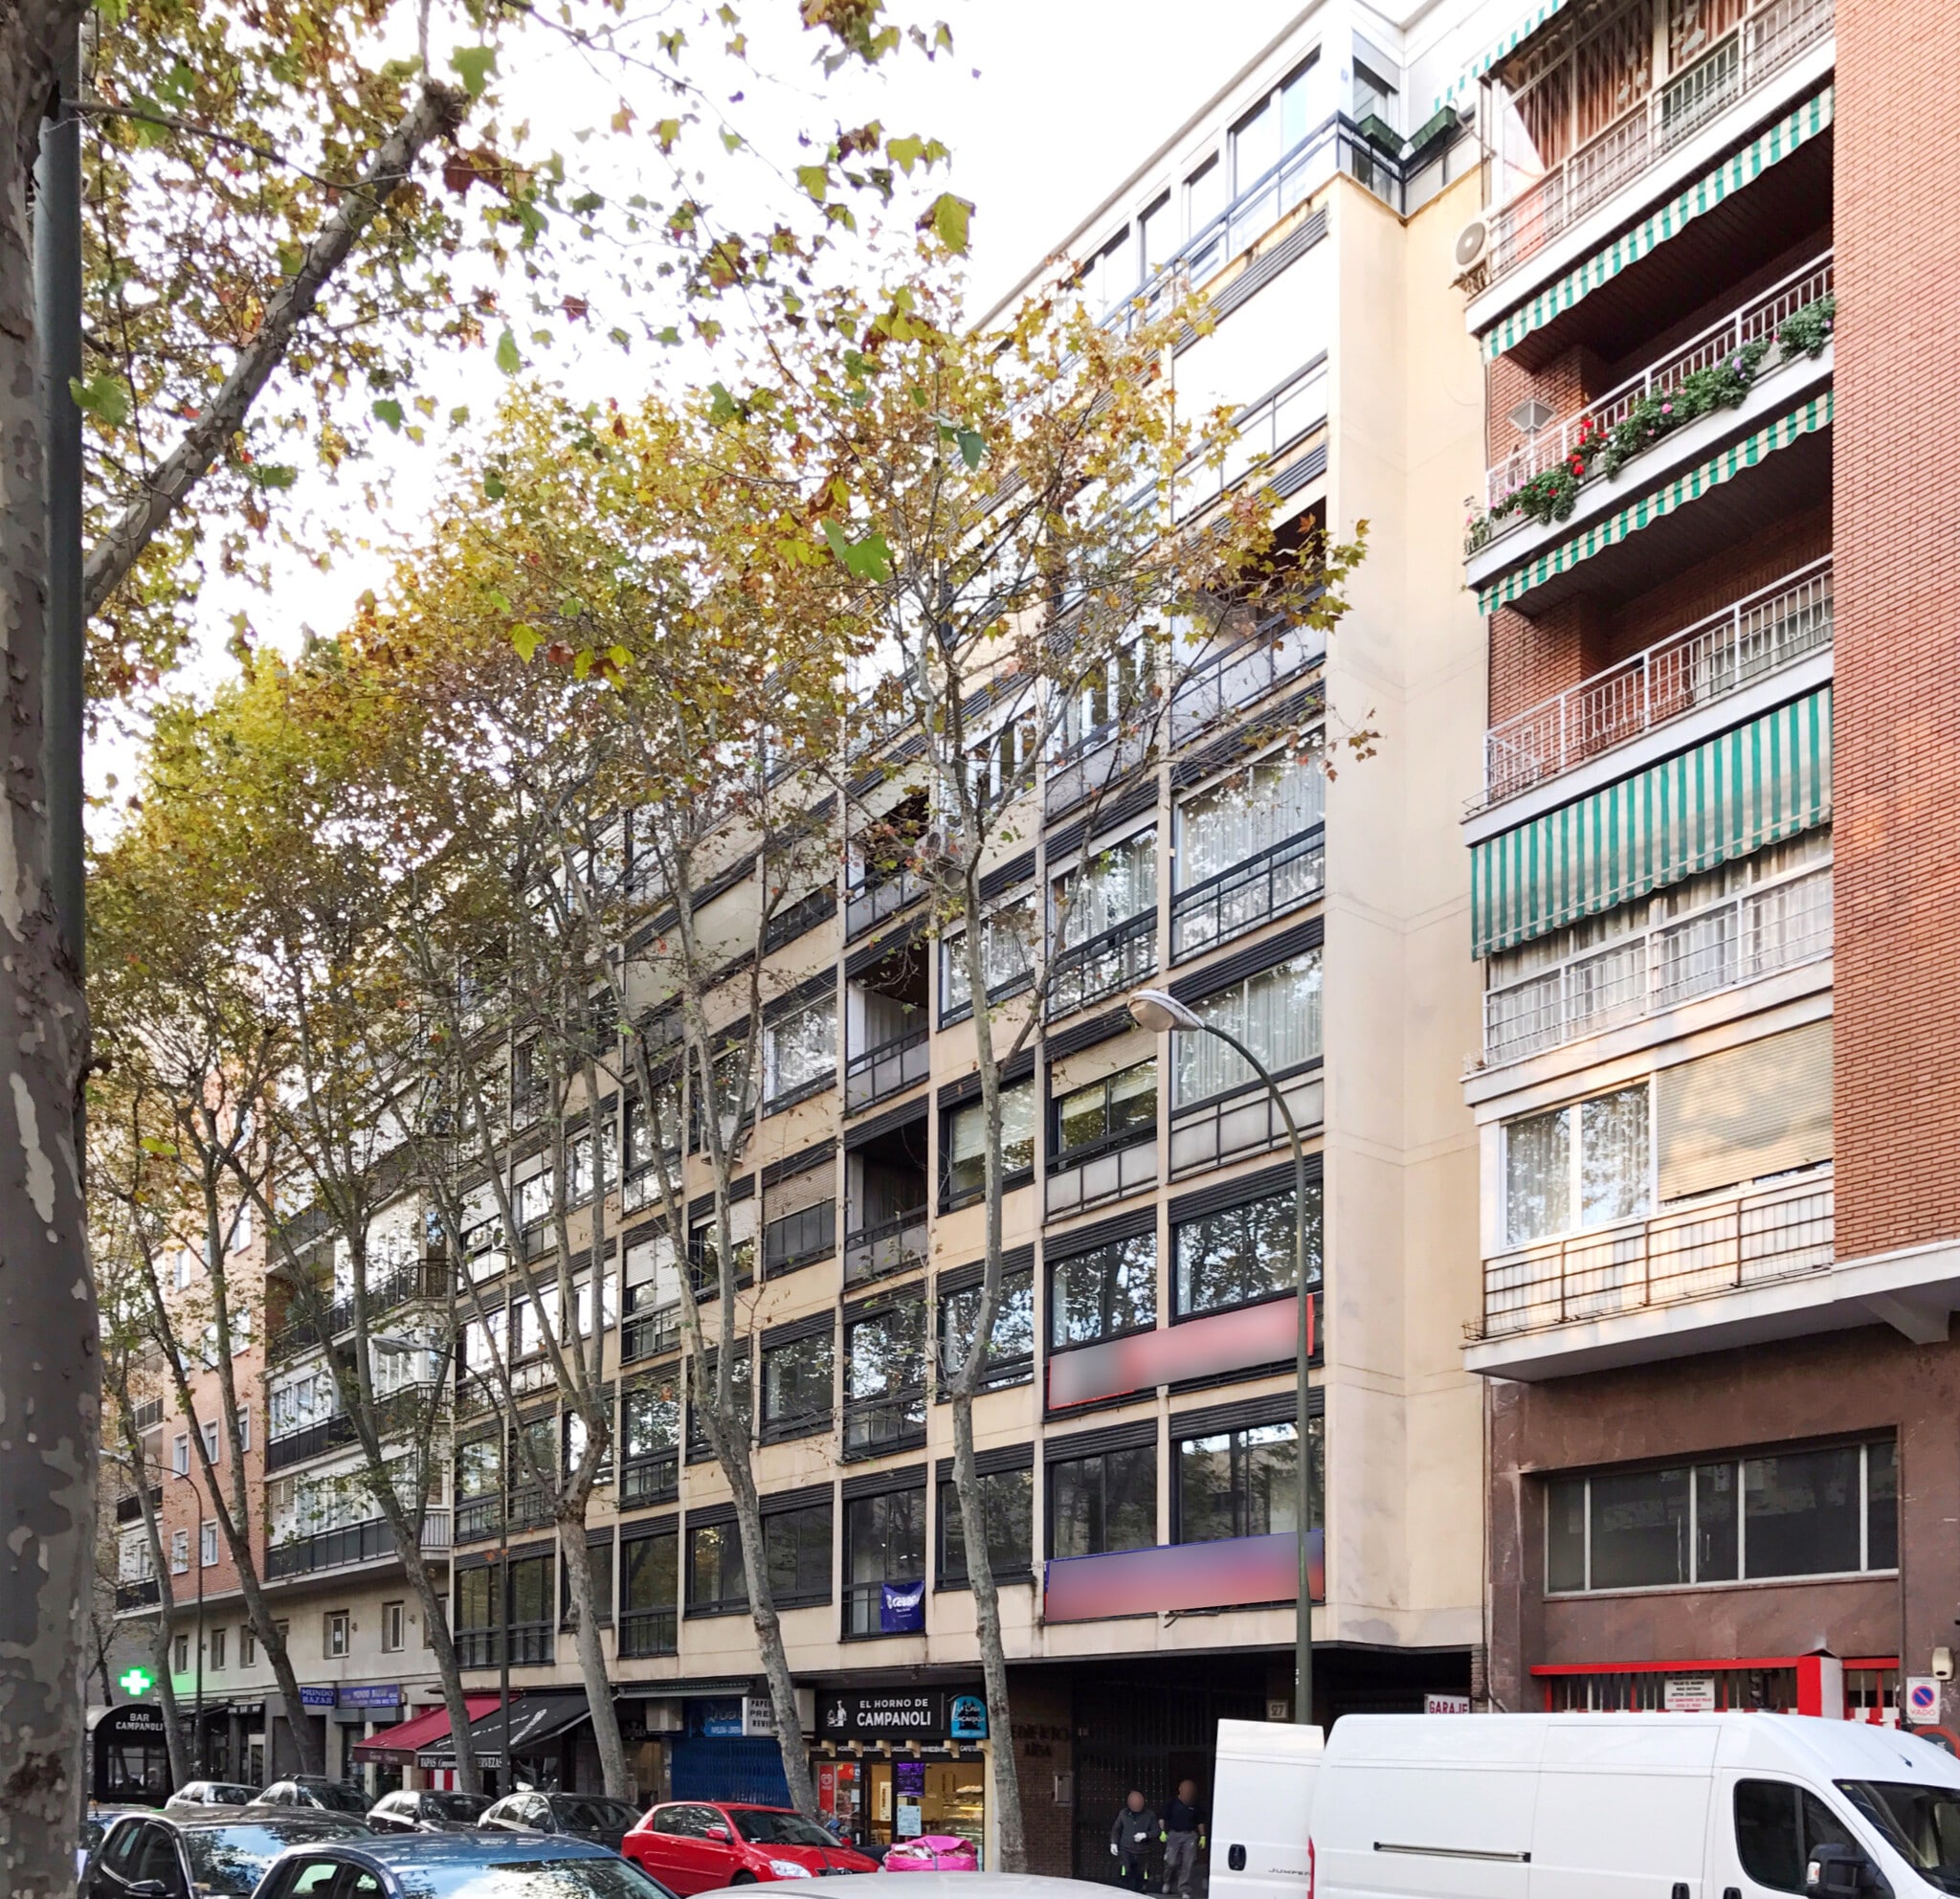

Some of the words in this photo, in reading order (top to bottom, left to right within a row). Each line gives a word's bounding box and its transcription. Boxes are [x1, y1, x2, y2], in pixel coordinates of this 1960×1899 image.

[859, 1700, 872, 1709] EL
[874, 1699, 911, 1709] HORNO
[914, 1698, 929, 1708] DE
[1429, 1700, 1468, 1714] GARAJE
[1271, 1705, 1284, 1716] 27
[129, 1712, 149, 1722] BAR
[857, 1710, 931, 1727] CAMPANOLI
[116, 1721, 164, 1731] CAMPANOLI
